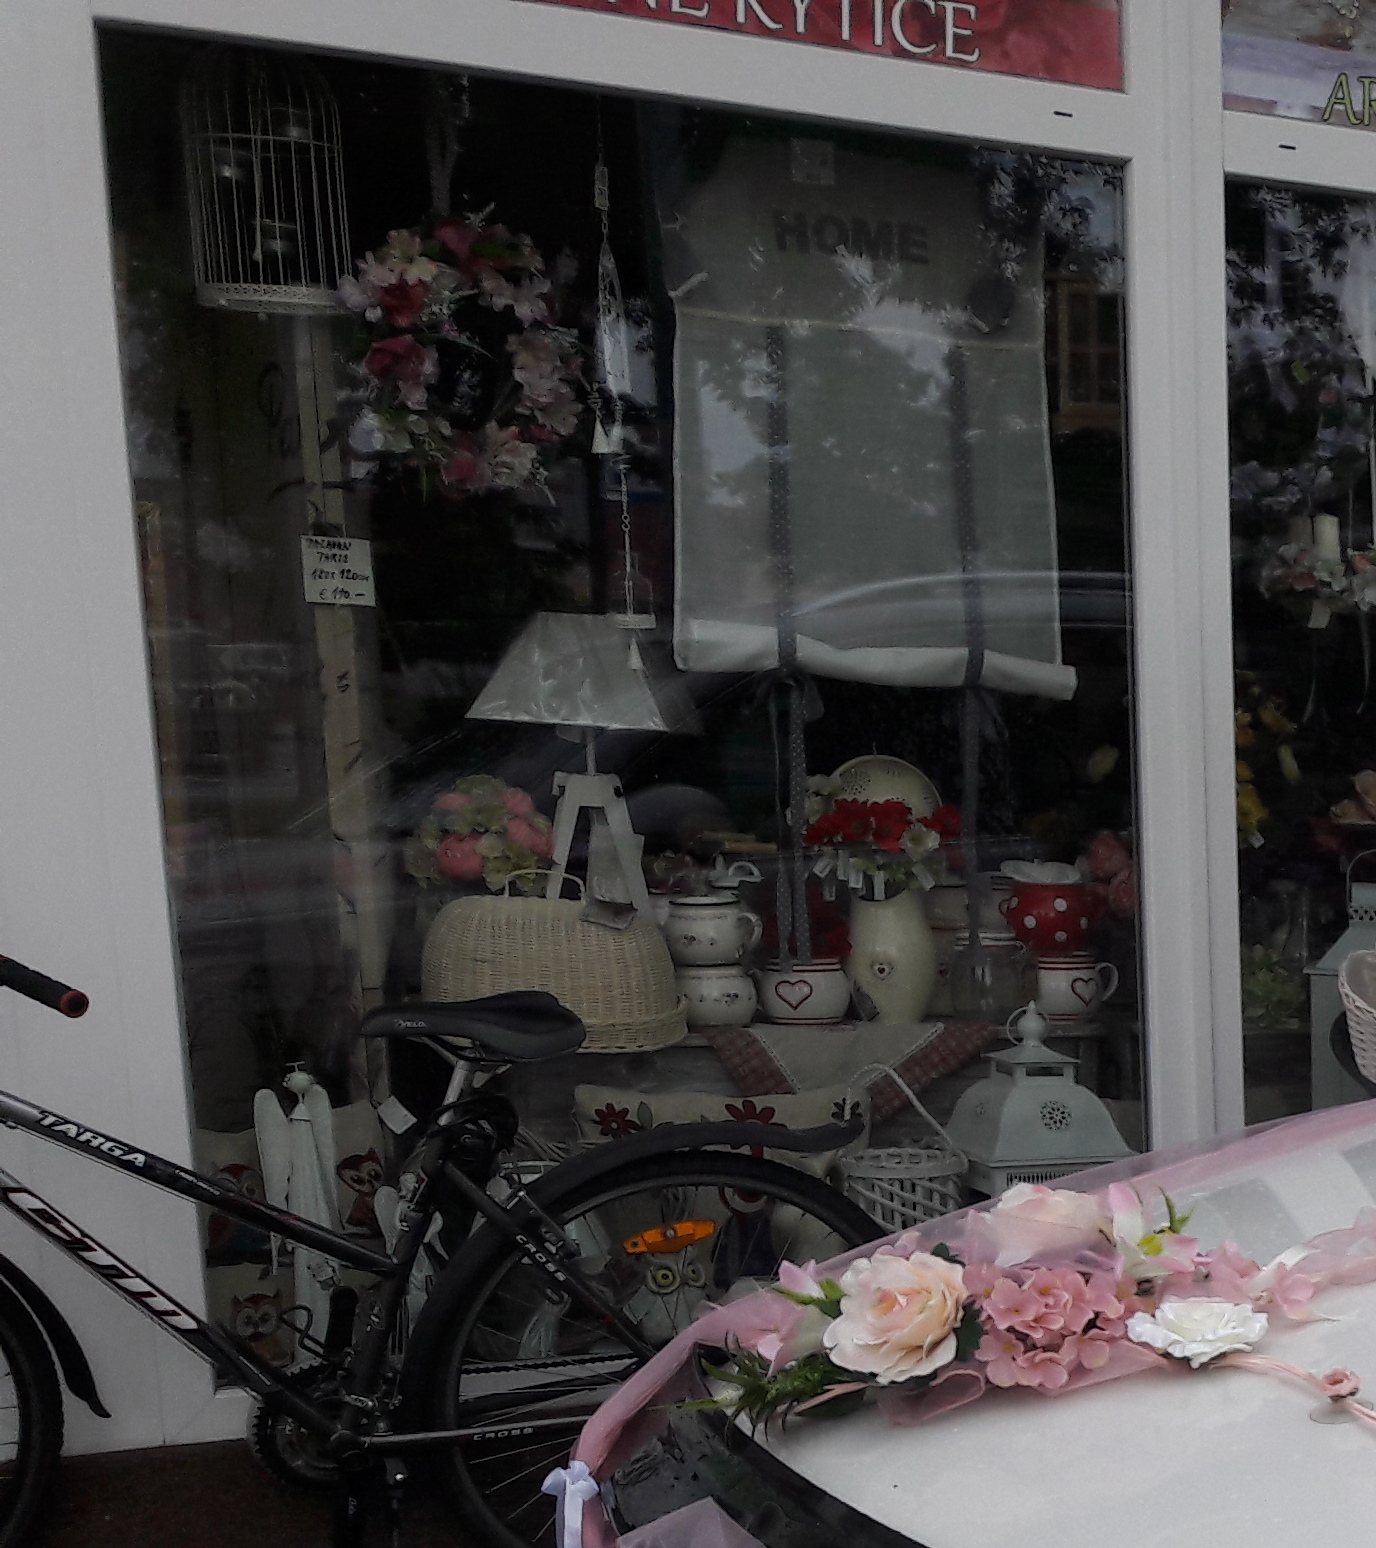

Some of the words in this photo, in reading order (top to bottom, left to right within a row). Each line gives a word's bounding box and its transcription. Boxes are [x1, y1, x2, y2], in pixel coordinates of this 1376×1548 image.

[773, 209, 930, 265] HOME
[38, 1110, 149, 1169] TARGA
[513, 1232, 568, 1284] CROSS
[471, 1426, 535, 1442] CROSS
